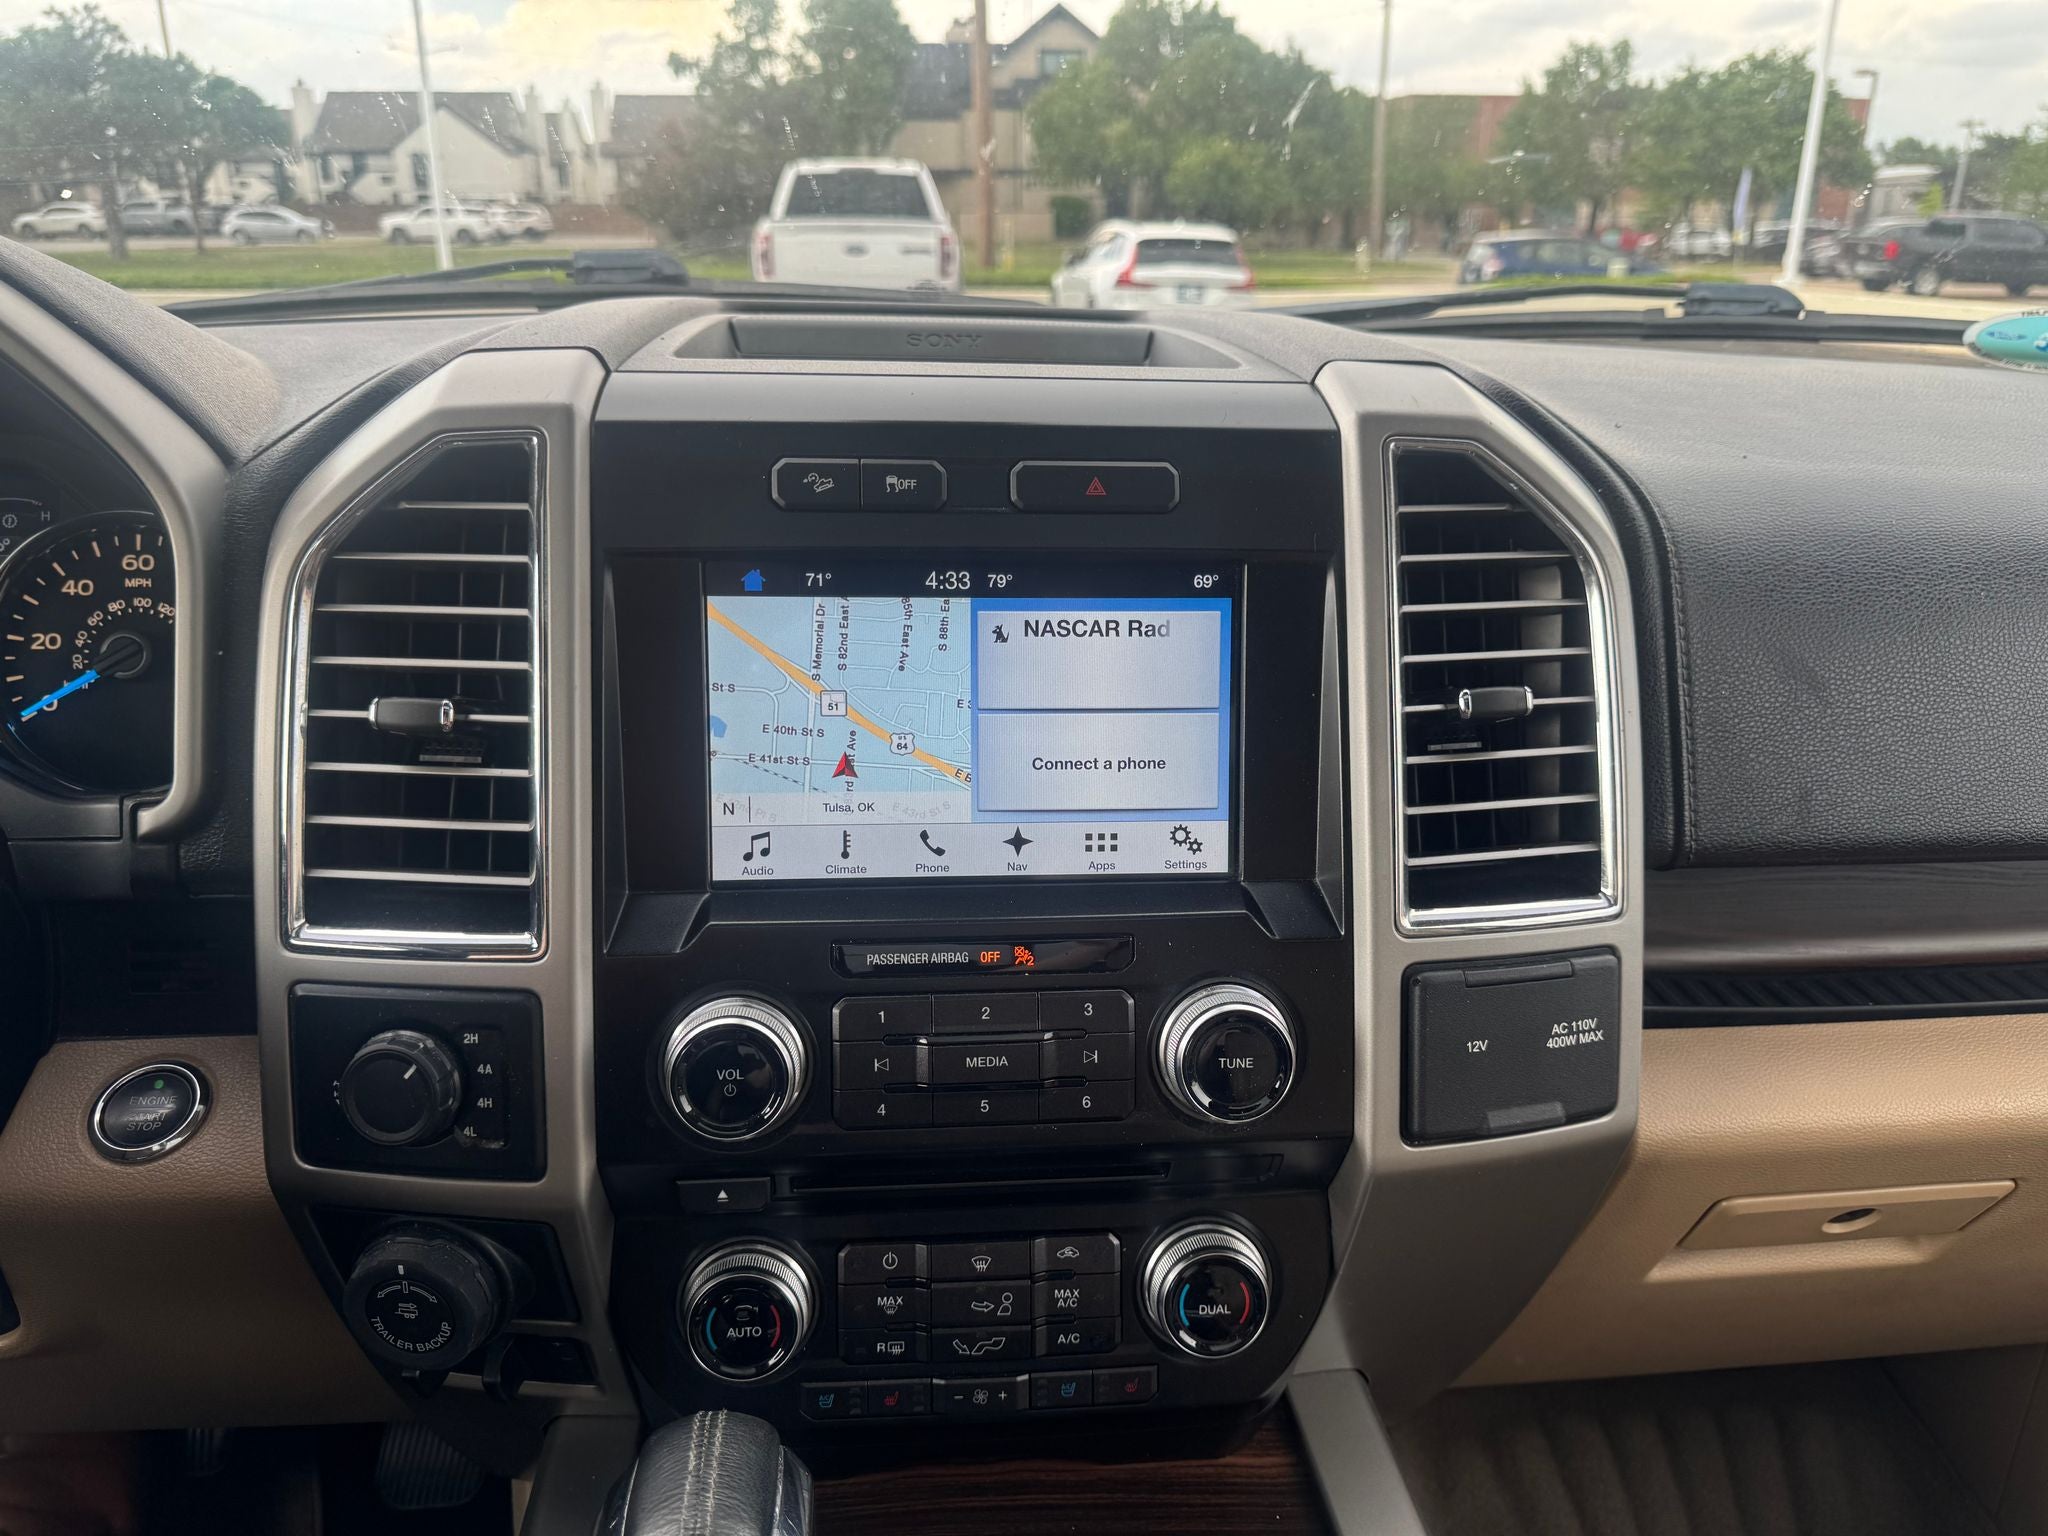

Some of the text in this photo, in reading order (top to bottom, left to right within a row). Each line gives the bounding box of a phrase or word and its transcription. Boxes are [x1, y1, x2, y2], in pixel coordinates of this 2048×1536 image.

[906, 333, 982, 349] SONY
[898, 479, 917, 490] OFF
[41, 511, 51, 521] H
[122, 554, 155, 571] 60
[124, 578, 152, 588] MPH
[806, 573, 832, 587] 71°
[925, 571, 971, 590] 4:33
[987, 574, 1013, 588] 79°
[1193, 574, 1219, 588] 69°
[61, 580, 94, 596] 40
[108, 600, 126, 612] 80
[133, 597, 152, 608] 100
[87, 611, 104, 626] 60
[840, 604, 850, 630] East
[940, 616, 949, 640] 88th
[1024, 619, 1121, 638] NASCAR
[1128, 619, 1170, 638] Rad
[30, 633, 62, 650] 20
[75, 630, 88, 648] 40
[902, 624, 913, 648] East
[811, 603, 826, 682] S Memorial Dr
[838, 634, 848, 659] 82nd
[938, 644, 948, 652] S
[72, 654, 83, 670] 20
[838, 663, 847, 672] S
[899, 652, 909, 672] Ave
[712, 682, 736, 693] St S
[828, 703, 838, 711] 51
[957, 698, 964, 708] E
[762, 724, 824, 738] E 40th St S
[847, 730, 857, 751] Ave
[896, 742, 908, 750] 64
[748, 753, 810, 766] E 41st St S
[1032, 757, 1166, 773] Connect a phone
[723, 803, 735, 816] N
[823, 802, 876, 814] Tulsa, OK
[742, 866, 774, 876] Audio
[825, 864, 867, 874] Climate
[916, 863, 950, 873] Phone
[1007, 861, 1028, 872] Nav
[1088, 861, 1116, 873] Apps
[1164, 860, 1208, 871] Settings
[866, 954, 928, 966] PASSENGER
[930, 952, 969, 964] AIRBAG
[980, 951, 1000, 963] OFF
[981, 1007, 990, 1020] 2
[1084, 1003, 1093, 1016] 3
[878, 1011, 885, 1024] 1
[1552, 1018, 1598, 1036] AC 110V
[463, 1034, 479, 1044] 2H
[1546, 1030, 1604, 1049] 400W MAX
[1466, 1040, 1488, 1053] 12V
[966, 1056, 1009, 1068] MEDIA
[1218, 1058, 1254, 1068] TUNE
[477, 1064, 493, 1074] 4A
[716, 1068, 745, 1080] VOL
[129, 1096, 178, 1106] ENGINE
[477, 1098, 493, 1108] 4H
[980, 1100, 990, 1113] 5
[1082, 1096, 1091, 1109] 6
[877, 1104, 886, 1116] 4
[126, 1122, 162, 1132] STOP
[463, 1127, 478, 1137] 4L
[1054, 1288, 1080, 1298] MAX
[877, 1296, 904, 1306] MAX
[1057, 1298, 1078, 1308] A/C
[1199, 1304, 1232, 1315] DUAL
[371, 1316, 453, 1352] TRAILER BACKUP
[726, 1326, 762, 1338] AUTO
[1057, 1333, 1080, 1344] A/C
[877, 1342, 886, 1352] R
